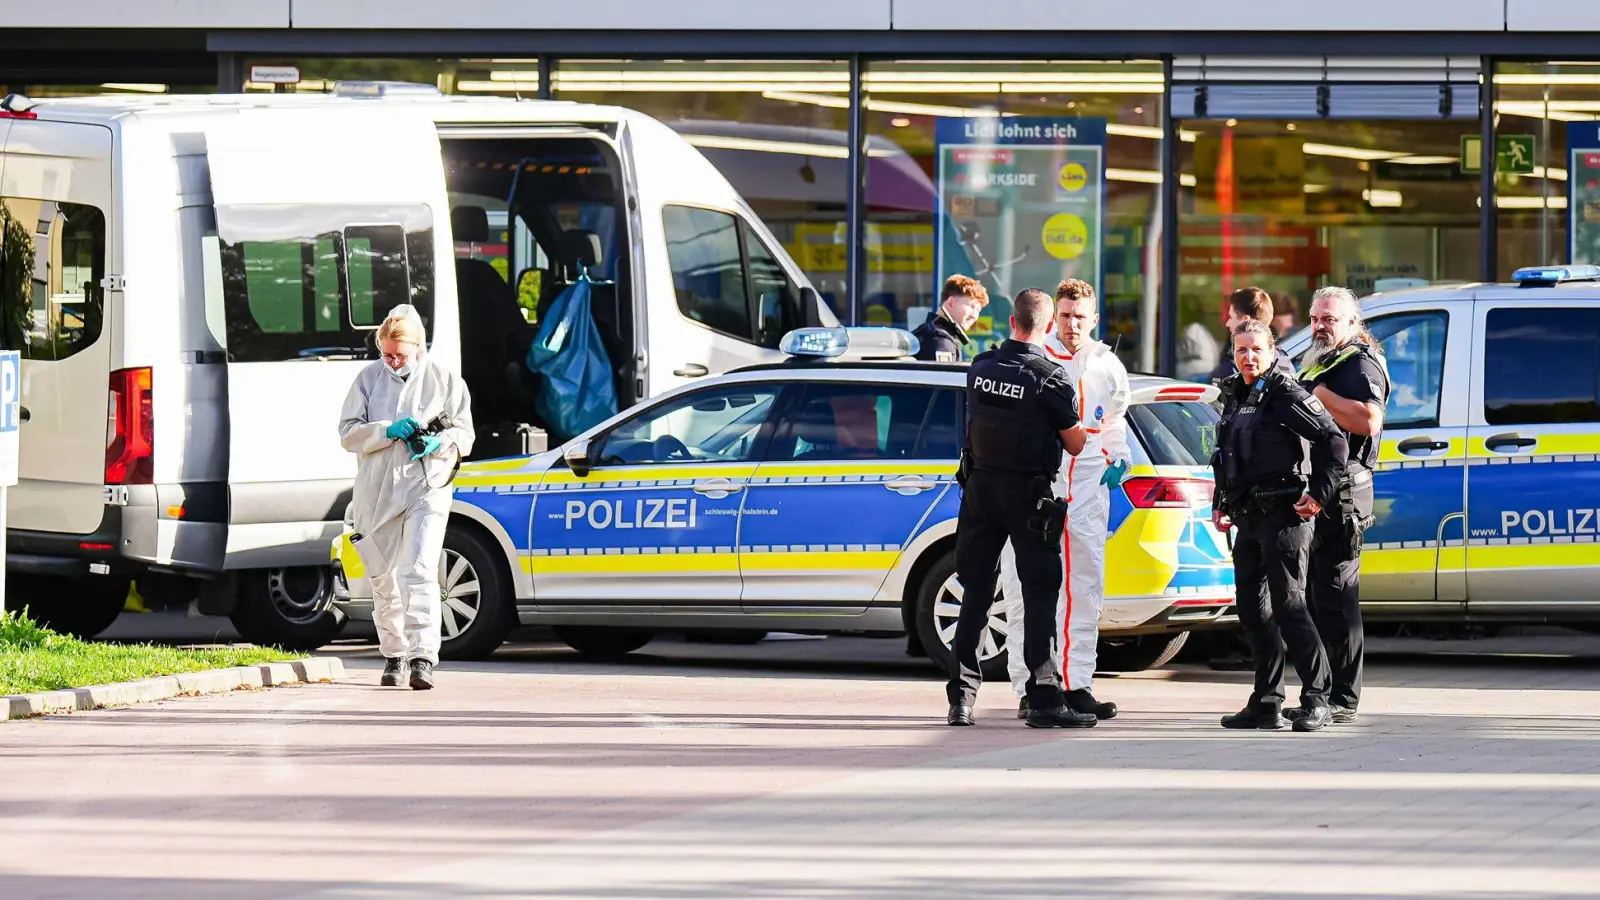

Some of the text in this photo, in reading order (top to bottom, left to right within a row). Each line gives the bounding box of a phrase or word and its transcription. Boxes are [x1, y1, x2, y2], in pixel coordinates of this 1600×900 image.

[964, 123, 1077, 138] Lidl lohnt sich
[1, 359, 16, 428] P
[973, 376, 1025, 400] POLIZEI
[1238, 406, 1257, 415] POLIZEI
[565, 499, 697, 529] POLIZEI
